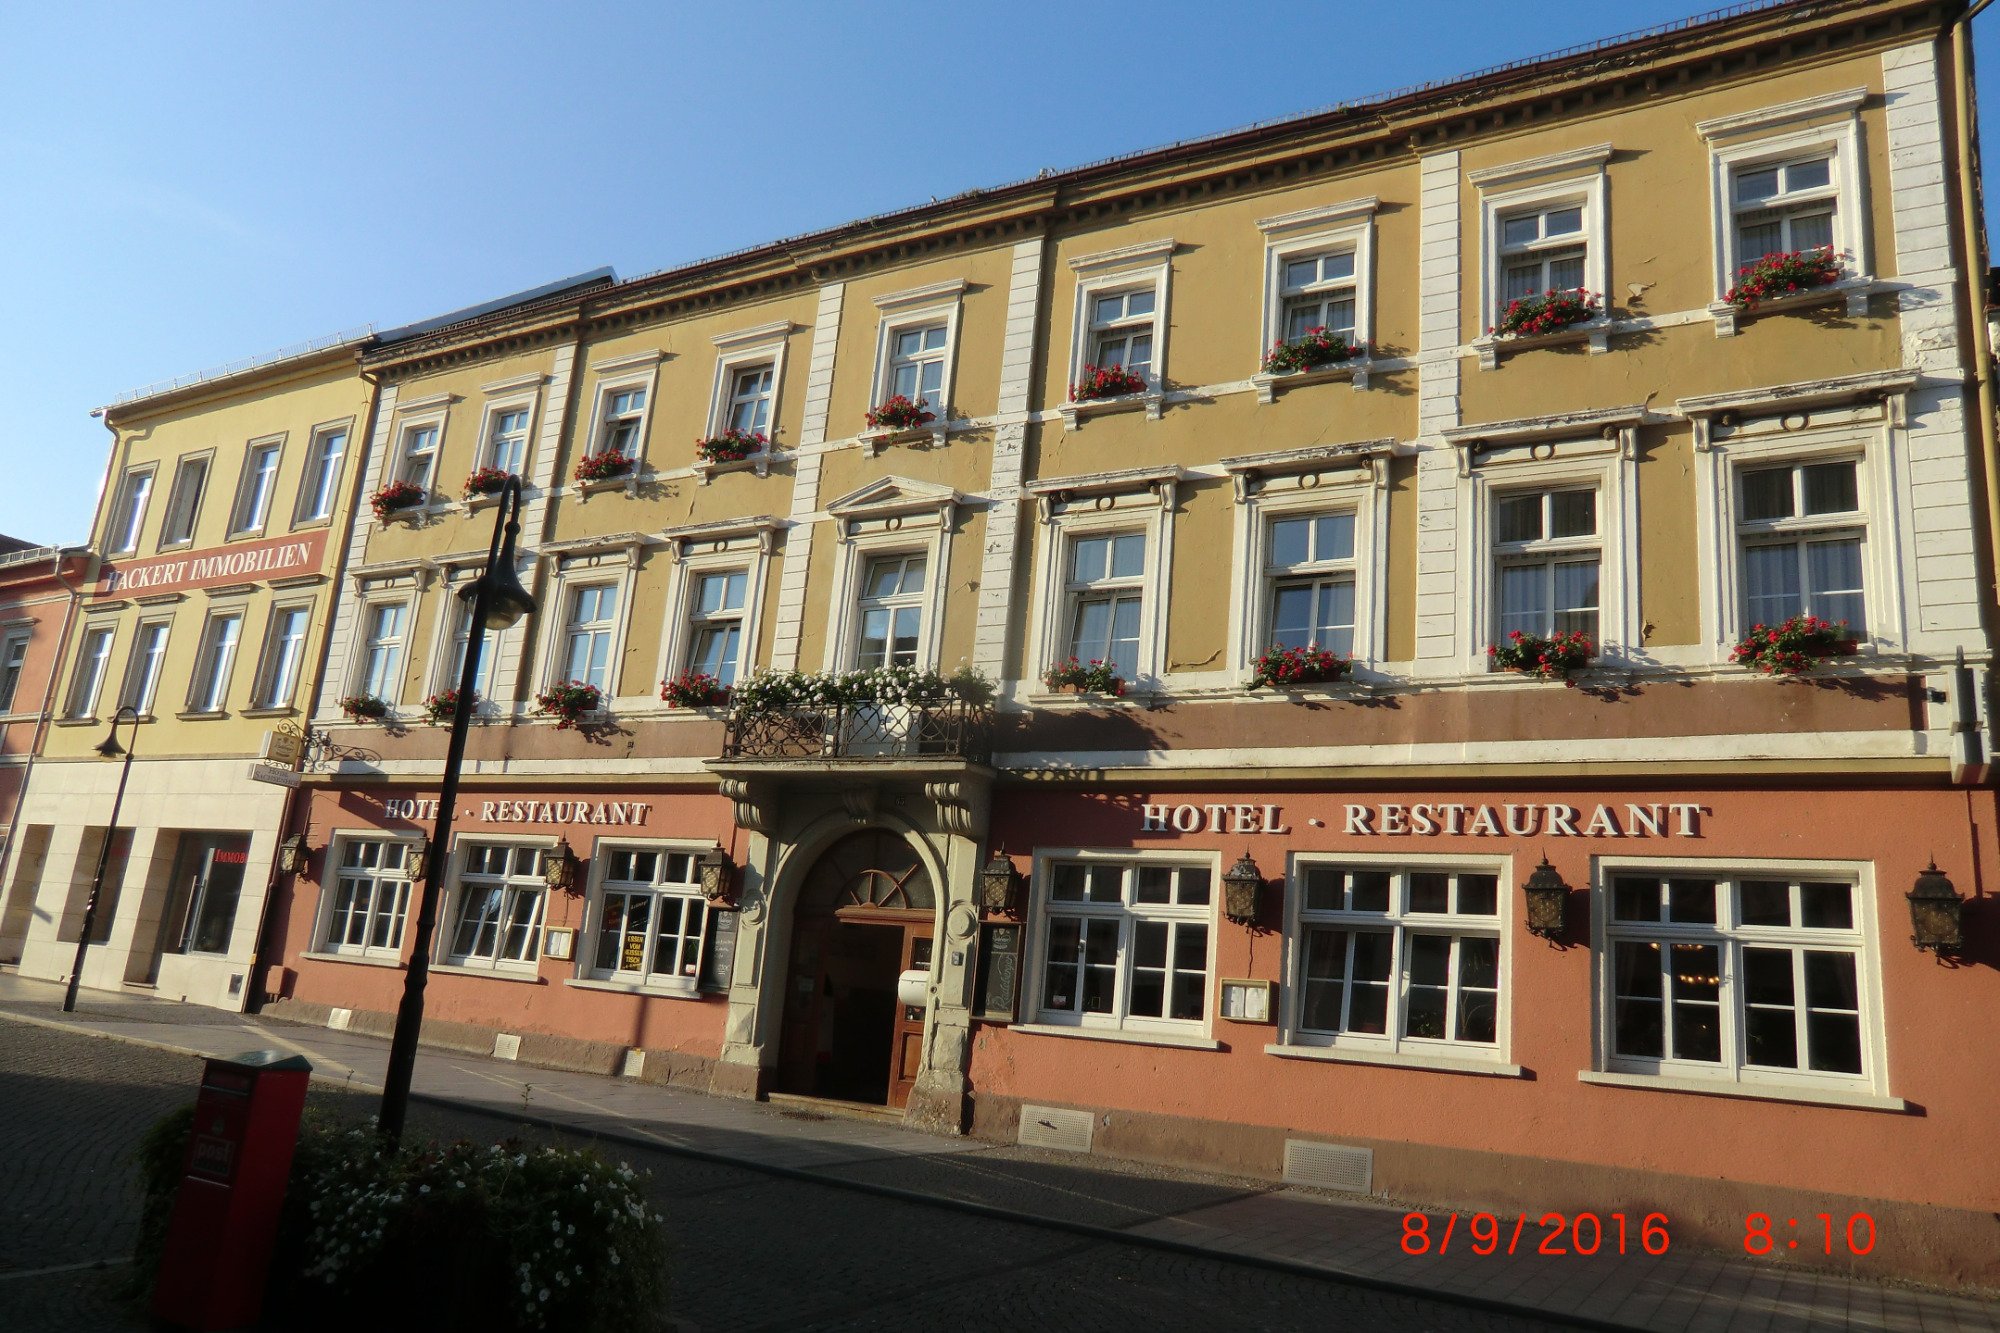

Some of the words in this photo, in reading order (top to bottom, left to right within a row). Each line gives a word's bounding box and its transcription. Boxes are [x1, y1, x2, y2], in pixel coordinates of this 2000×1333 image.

[105, 562, 188, 592] HACKERT
[189, 541, 313, 581] IMMOBILIEN
[385, 798, 446, 821] HOTE
[481, 800, 648, 826] RESTAURANT
[1141, 803, 1286, 834] HOTEL
[1342, 803, 1703, 837] RESTAURANT
